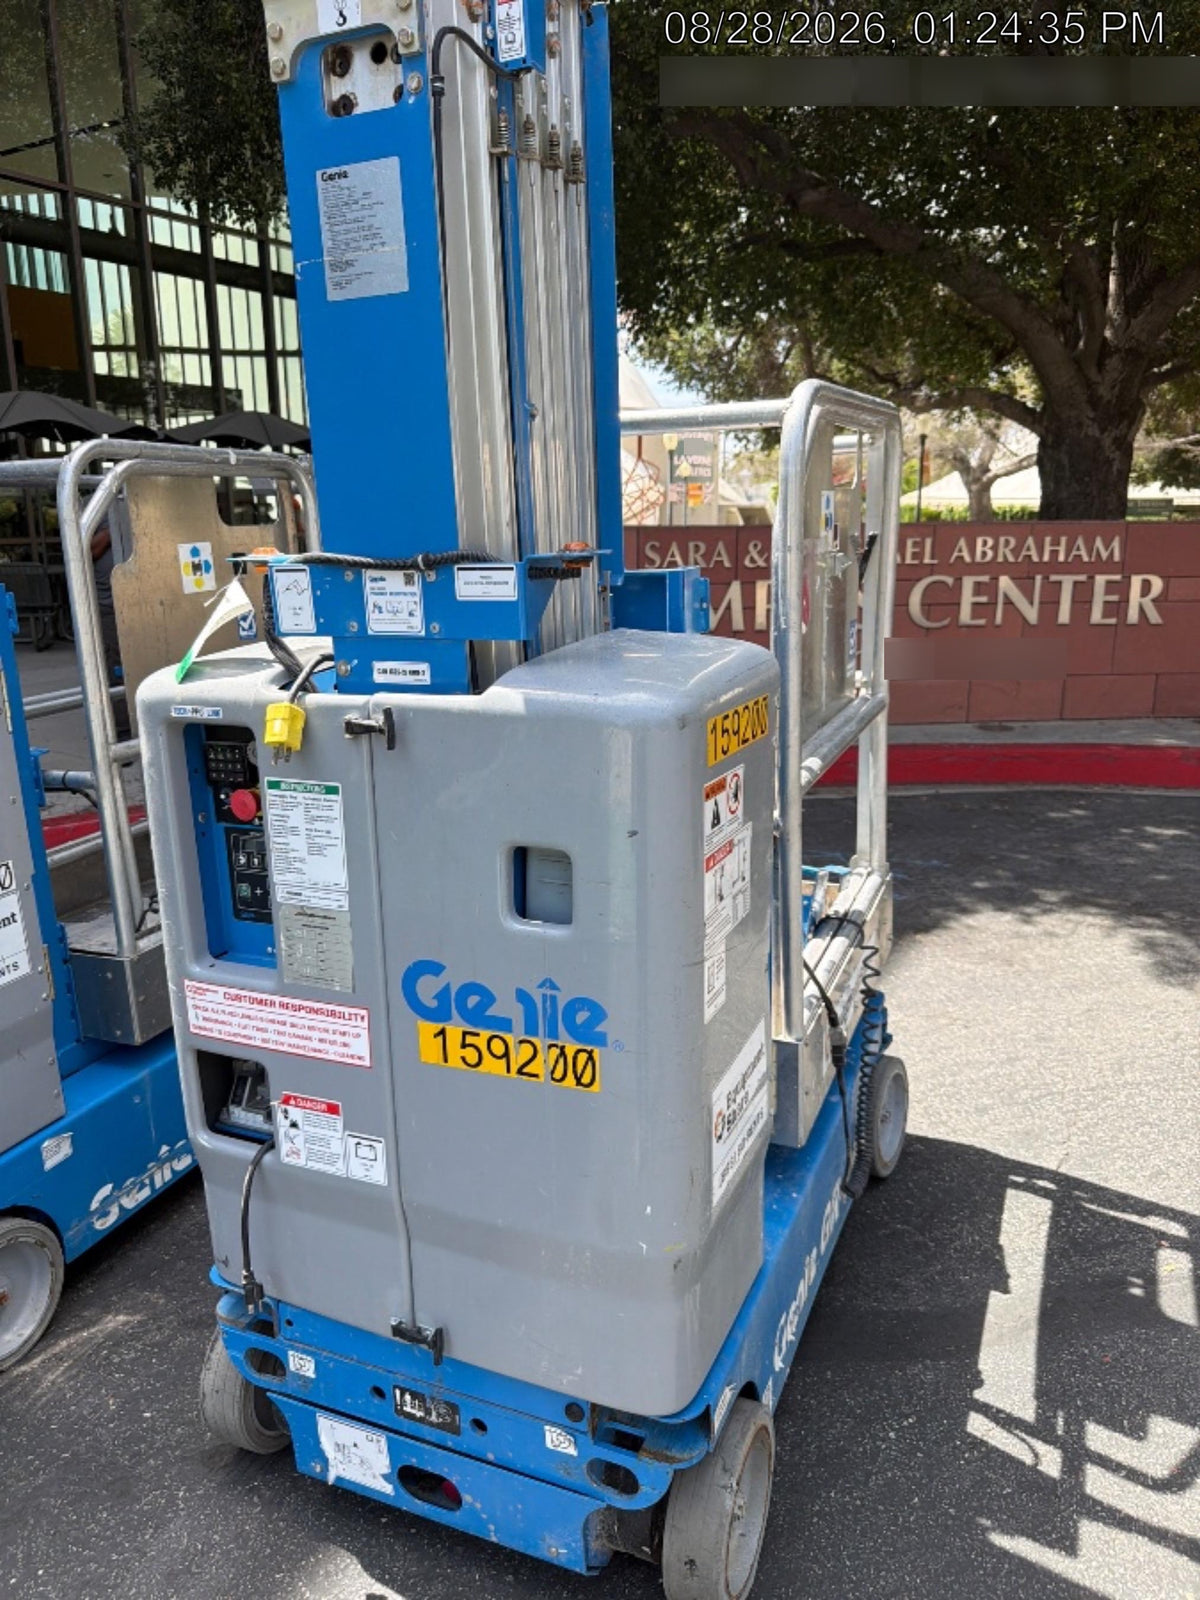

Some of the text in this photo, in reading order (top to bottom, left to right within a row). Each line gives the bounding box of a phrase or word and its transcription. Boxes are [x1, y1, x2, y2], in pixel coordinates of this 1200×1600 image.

[320, 169, 349, 182] Genie
[644, 541, 732, 568] SARA
[744, 541, 769, 568] &
[949, 535, 1121, 563] ABRAHAM
[908, 573, 1164, 629] CENTER
[711, 697, 769, 761] 159200
[224, 991, 276, 1009] CUSTOMER
[279, 999, 366, 1023] RESPONSIBILITY
[401, 959, 609, 1047] Genie
[433, 1027, 598, 1089] 159200
